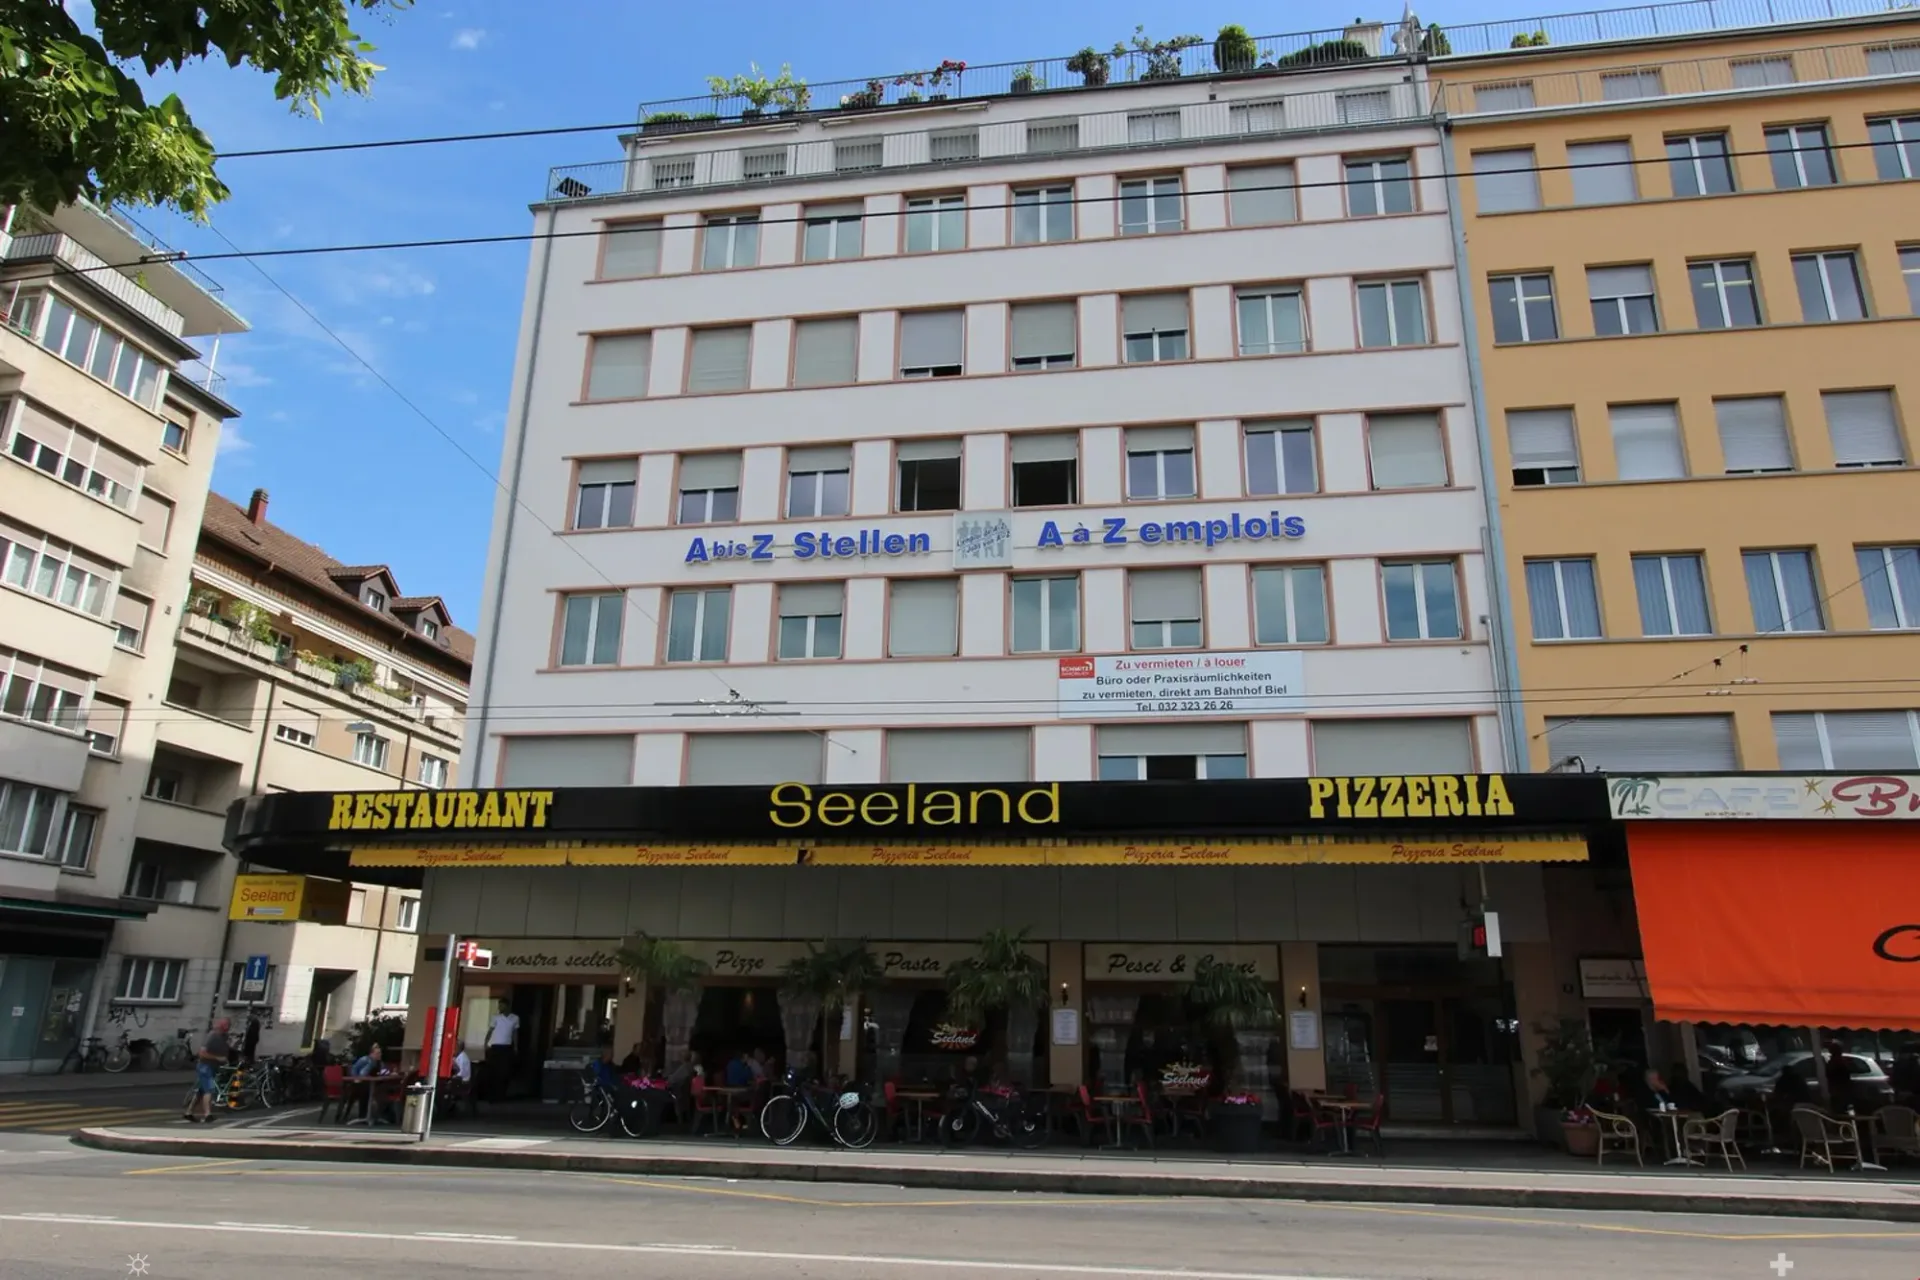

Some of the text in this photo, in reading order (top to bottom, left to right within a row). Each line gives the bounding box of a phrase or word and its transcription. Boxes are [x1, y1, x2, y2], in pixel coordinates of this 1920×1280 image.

[1037, 510, 1306, 549] A à Z emplois
[685, 529, 931, 564] A bis Z Stellen
[1115, 660, 1131, 670] Zu
[1134, 659, 1194, 670] vermieten
[1214, 657, 1246, 667] louer
[1096, 672, 1272, 685] Büro oder Praxisräumlichkeiten
[1098, 690, 1156, 699] vermieten,
[1159, 688, 1191, 697] direkt
[1193, 688, 1211, 697] am
[1214, 686, 1262, 696] Bahnhof
[1265, 685, 1287, 695] Biel
[1136, 700, 1233, 712] Tel. 032 323 26 26
[1308, 774, 1515, 818] PIZZERIA
[328, 791, 553, 830] RESTAURANT
[769, 782, 1060, 828] Seeland
[416, 849, 505, 865] Pizzeria Seeland
[637, 847, 731, 864] Pizzeria Seeland
[872, 847, 972, 864] Pizzeria Seeland
[1124, 846, 1230, 863] Pizzeria Seeland
[1391, 843, 1504, 861] Pizzeria Seeland
[240, 887, 296, 902] Seeland
[506, 951, 559, 967] nostra
[565, 951, 615, 967] scelta
[716, 950, 765, 974] Pizze
[885, 952, 942, 972] Pasta
[1108, 953, 1161, 973] Pesci
[1170, 954, 1186, 973] &
